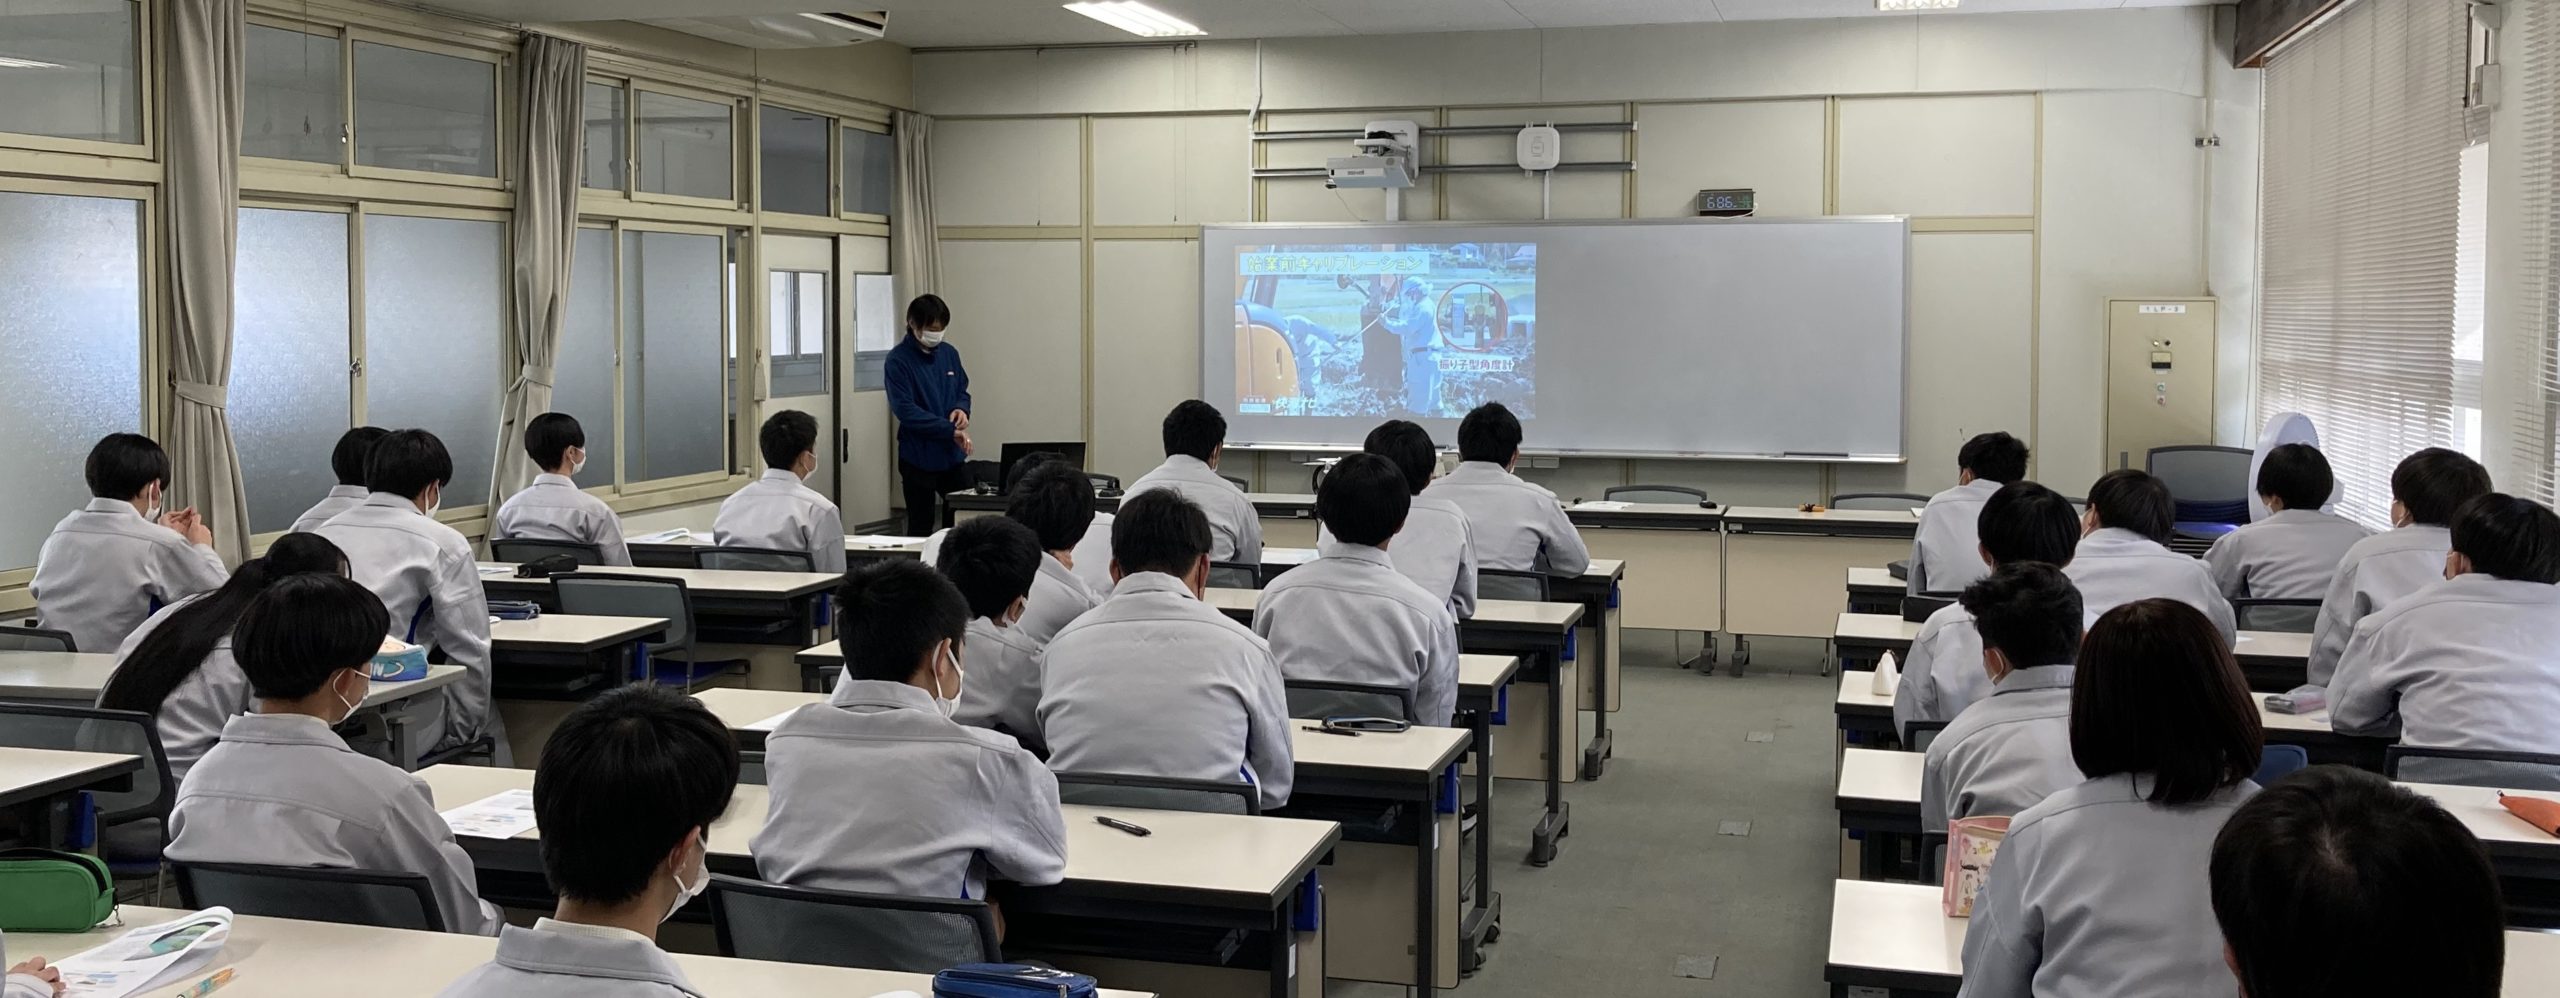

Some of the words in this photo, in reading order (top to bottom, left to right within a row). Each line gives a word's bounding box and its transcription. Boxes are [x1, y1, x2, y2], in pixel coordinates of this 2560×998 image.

[1247, 255, 1423, 273] 始業前キャリブレーション
